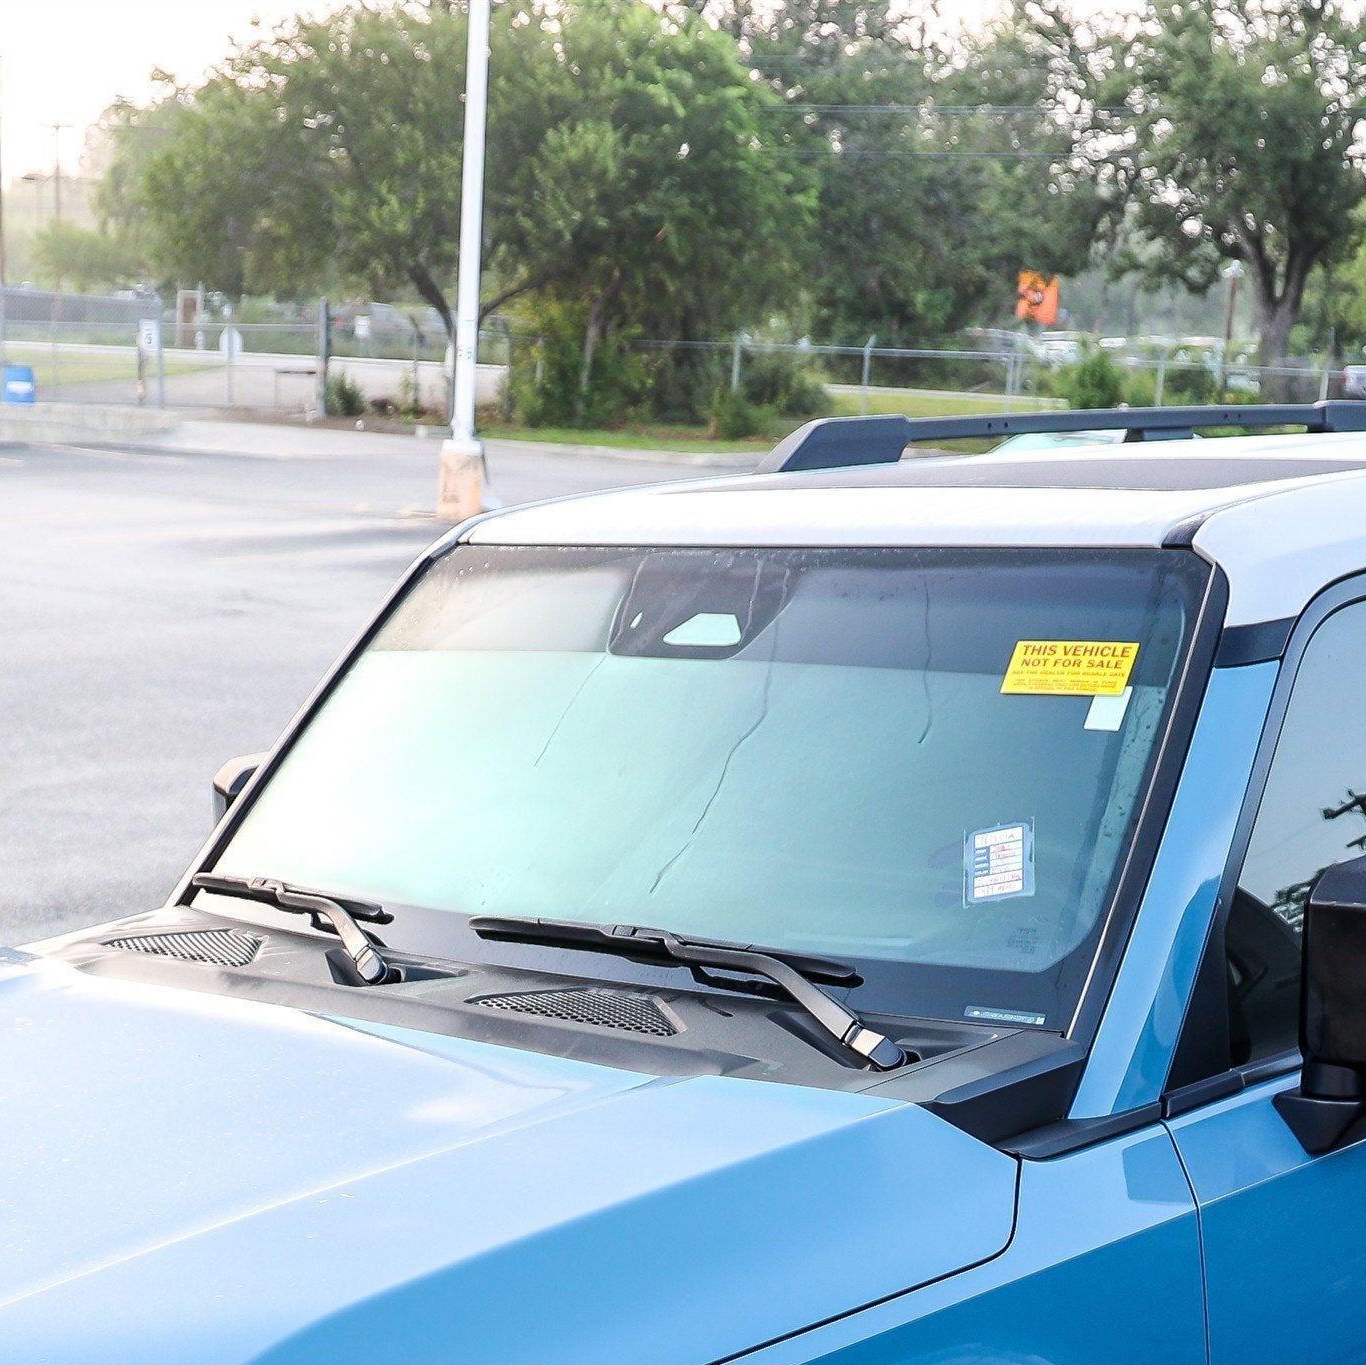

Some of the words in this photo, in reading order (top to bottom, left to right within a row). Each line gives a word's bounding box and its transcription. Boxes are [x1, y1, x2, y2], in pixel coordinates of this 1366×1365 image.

[1023, 645, 1057, 656] THIS
[1063, 645, 1132, 658] VEHICLE
[1021, 658, 1050, 667] NOT
[1053, 658, 1082, 668] FOR
[1086, 659, 1124, 669] SALE
